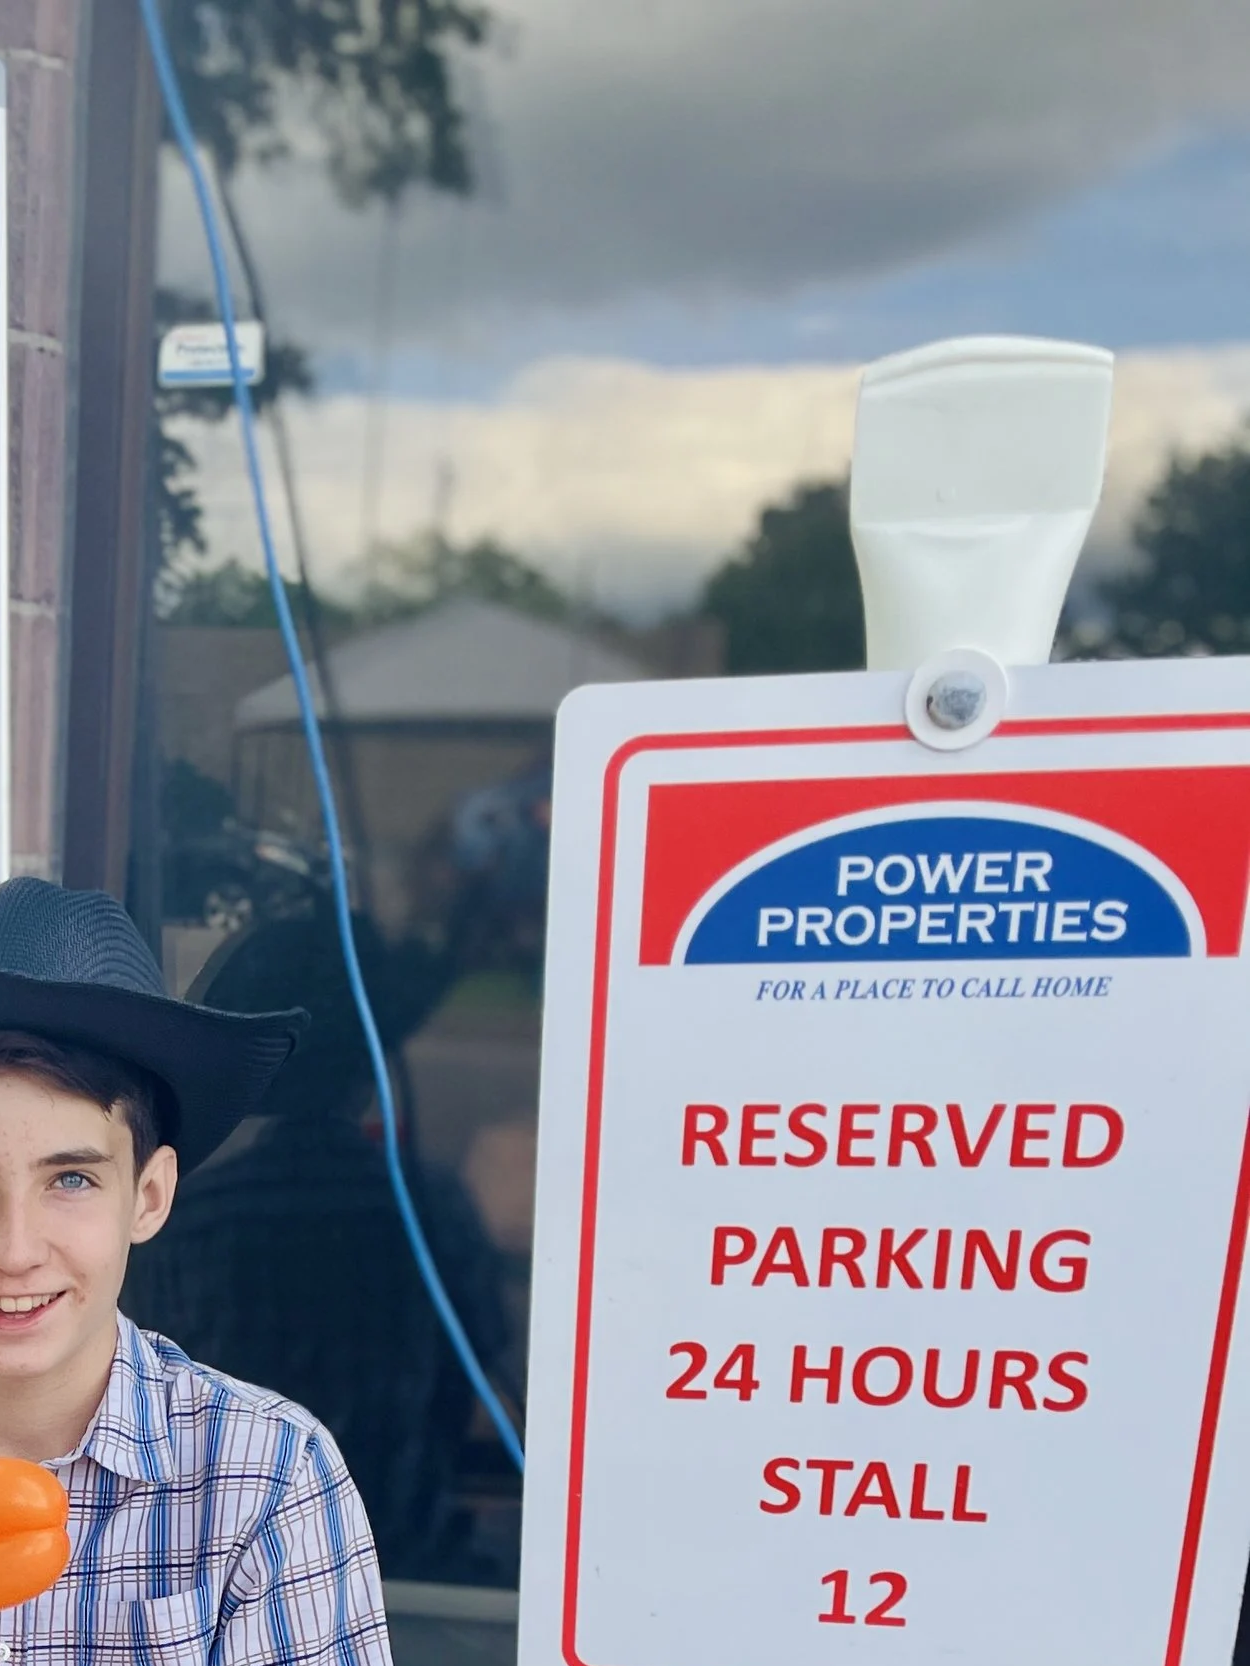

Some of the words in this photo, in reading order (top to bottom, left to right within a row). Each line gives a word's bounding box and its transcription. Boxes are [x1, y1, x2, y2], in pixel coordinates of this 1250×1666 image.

[837, 852, 1053, 896] POWER
[757, 900, 1129, 947] PROPERTIES
[756, 979, 806, 1001] FOR
[810, 980, 827, 1000] A
[834, 978, 916, 1000] PLACE
[922, 977, 956, 999] TO
[961, 977, 1026, 999] CALL
[1031, 975, 1113, 998] HOME
[682, 1103, 1124, 1168] RESERVED
[710, 1226, 1091, 1293] PARKING
[665, 1341, 760, 1401] 24
[789, 1345, 1089, 1412] HOURS
[759, 1457, 988, 1522] STALL
[818, 1569, 908, 1627] 12
